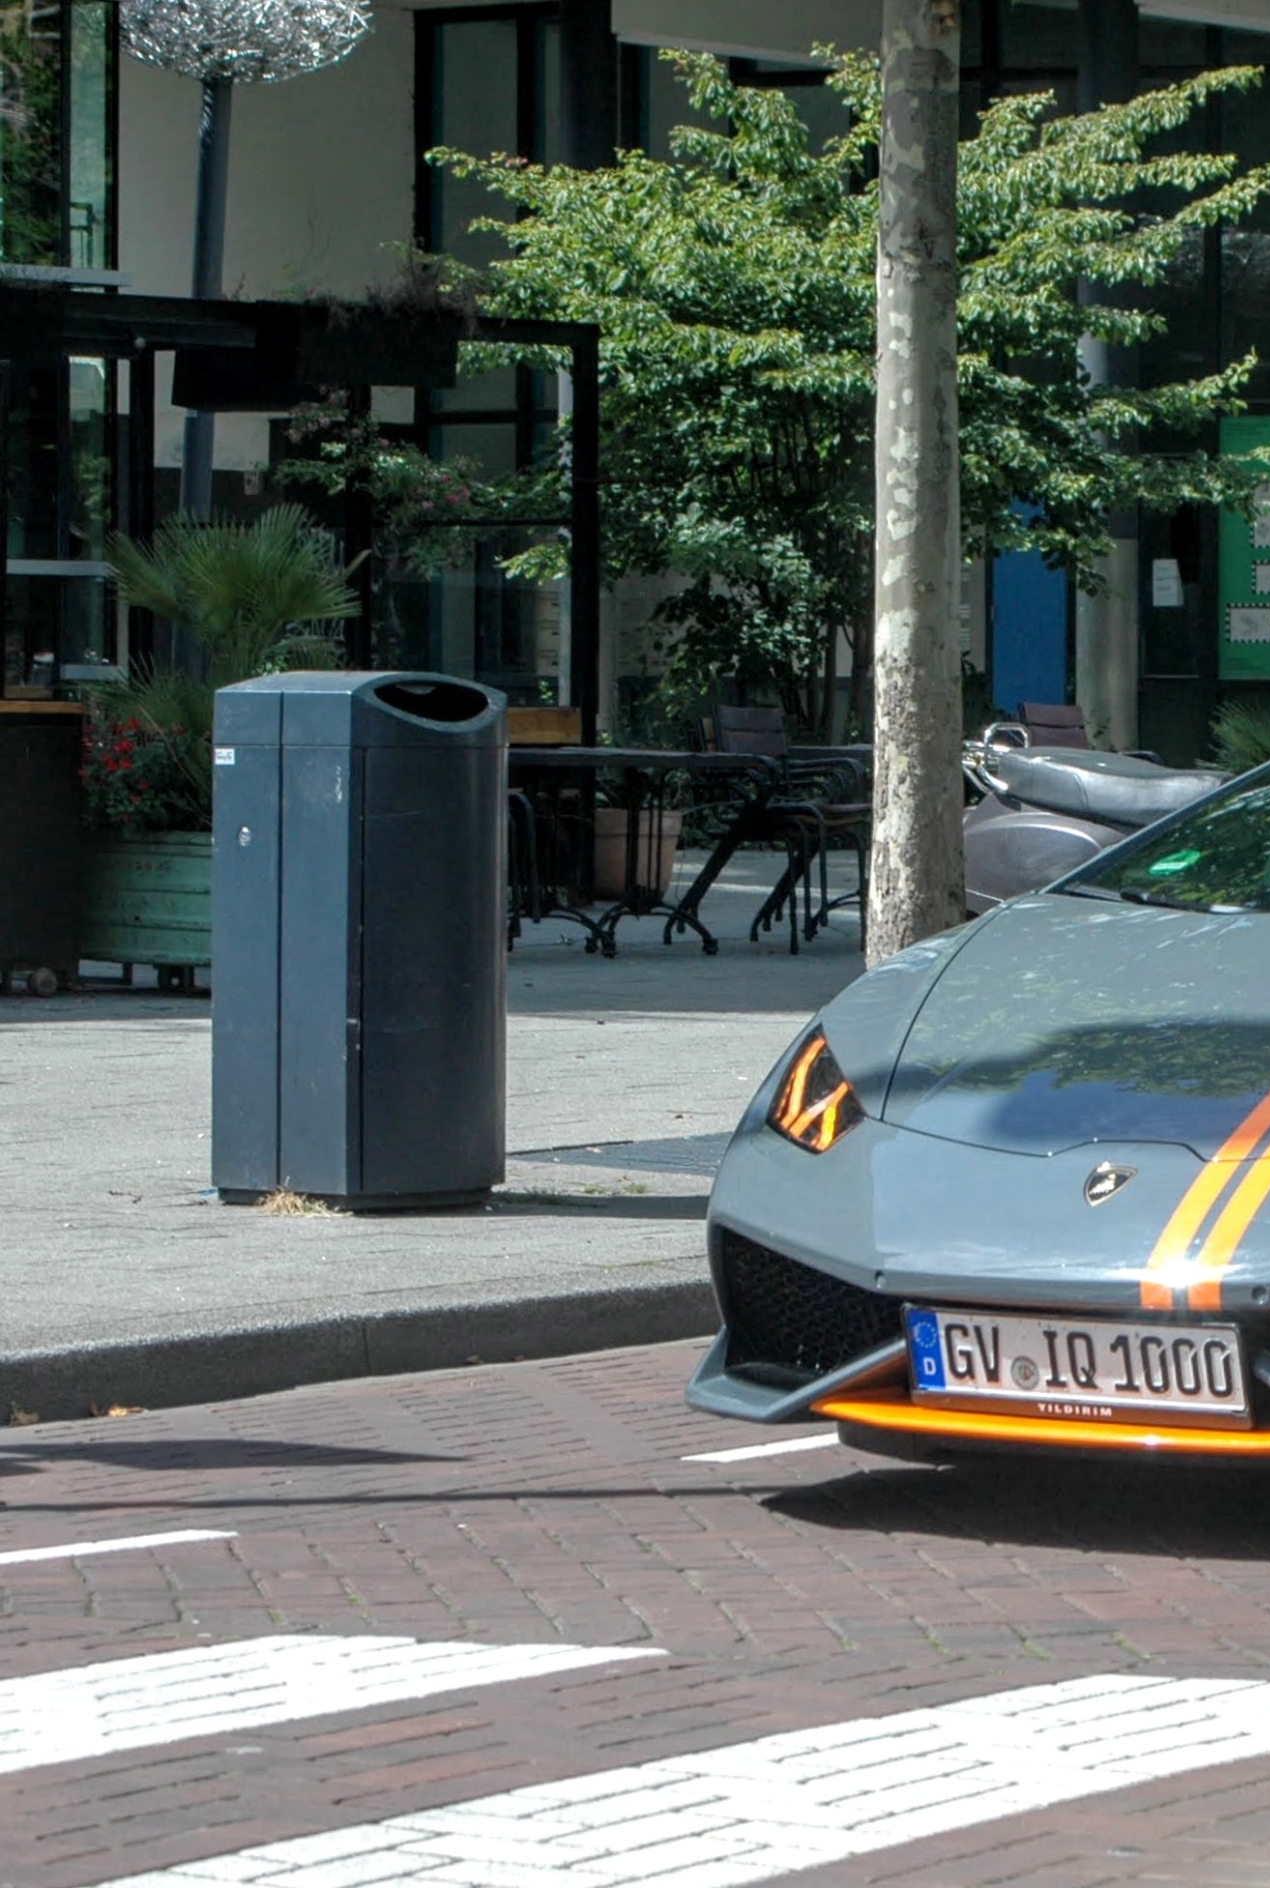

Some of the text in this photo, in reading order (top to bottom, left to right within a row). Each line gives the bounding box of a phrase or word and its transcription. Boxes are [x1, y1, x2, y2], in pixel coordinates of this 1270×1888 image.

[924, 1357, 937, 1376] D
[944, 1323, 1235, 1398] GV IQ 1000
[1037, 1402, 1113, 1417] YILDIRIM
